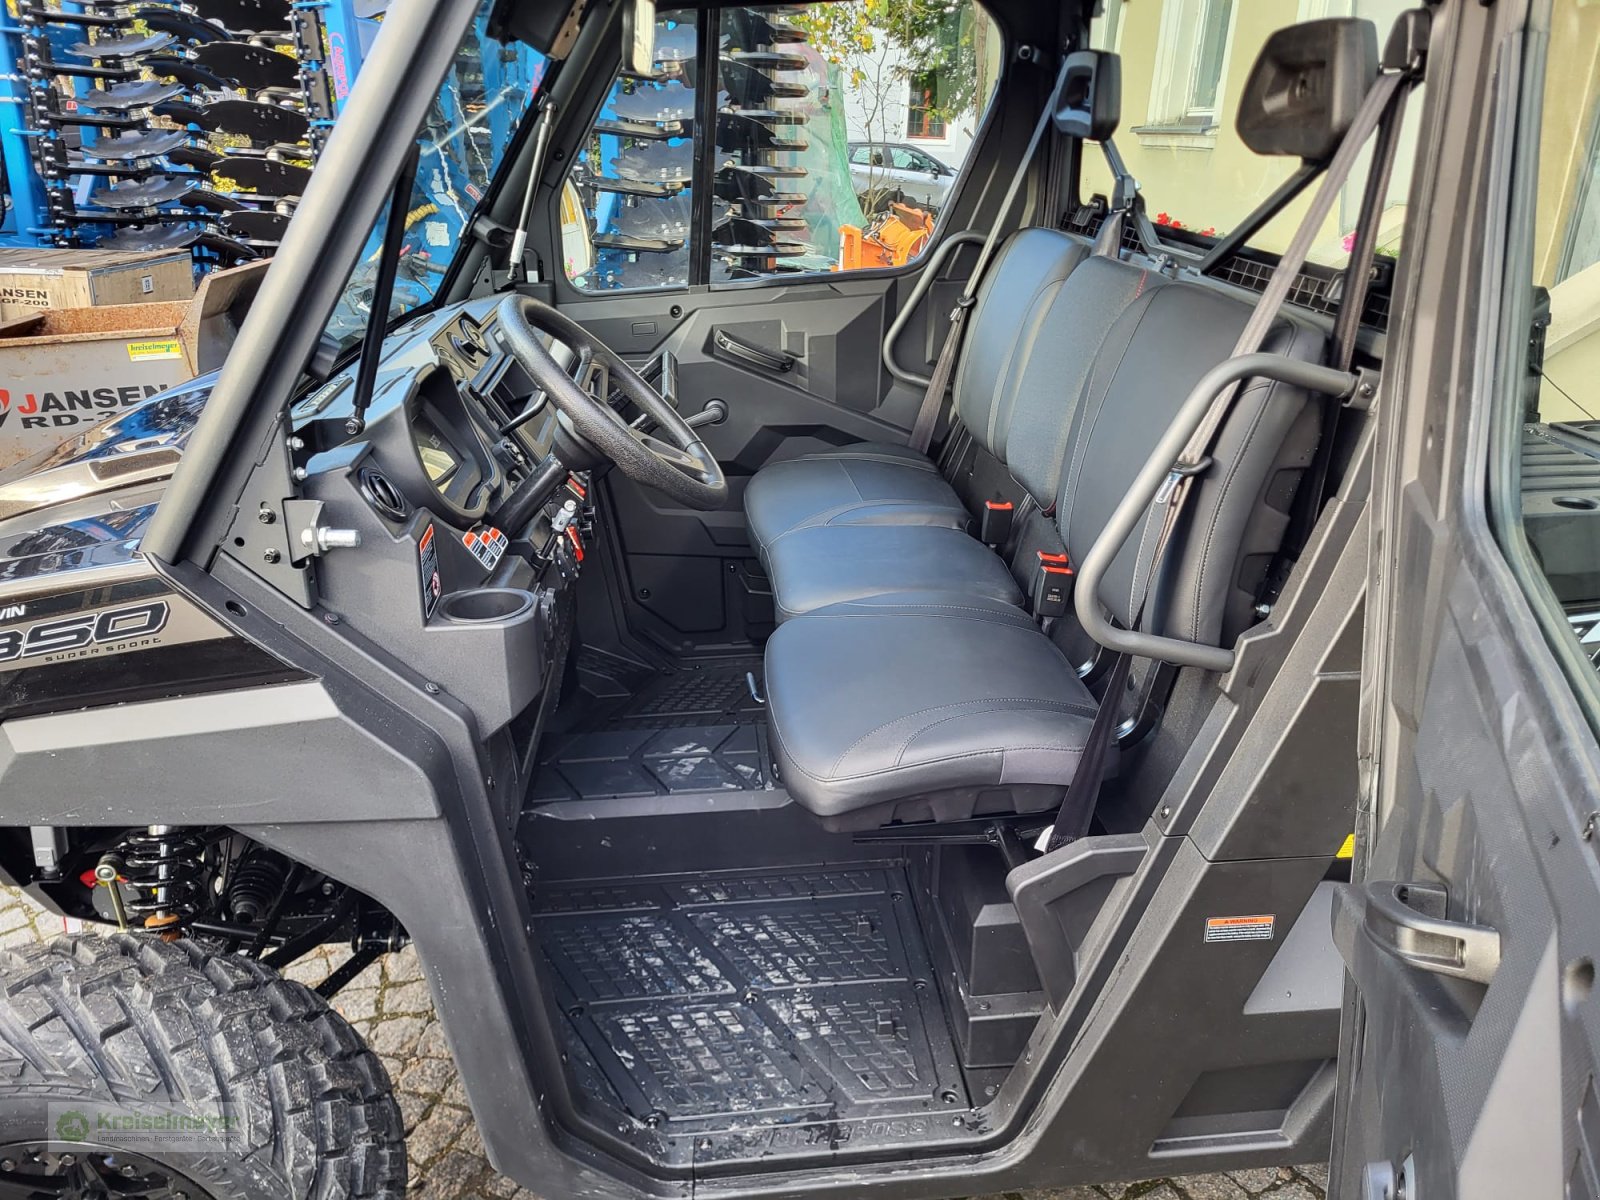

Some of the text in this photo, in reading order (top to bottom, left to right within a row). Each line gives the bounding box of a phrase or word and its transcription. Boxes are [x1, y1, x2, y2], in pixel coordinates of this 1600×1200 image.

[0, 288, 47, 299] NSEN
[45, 637, 162, 662] SUPER SPORT
